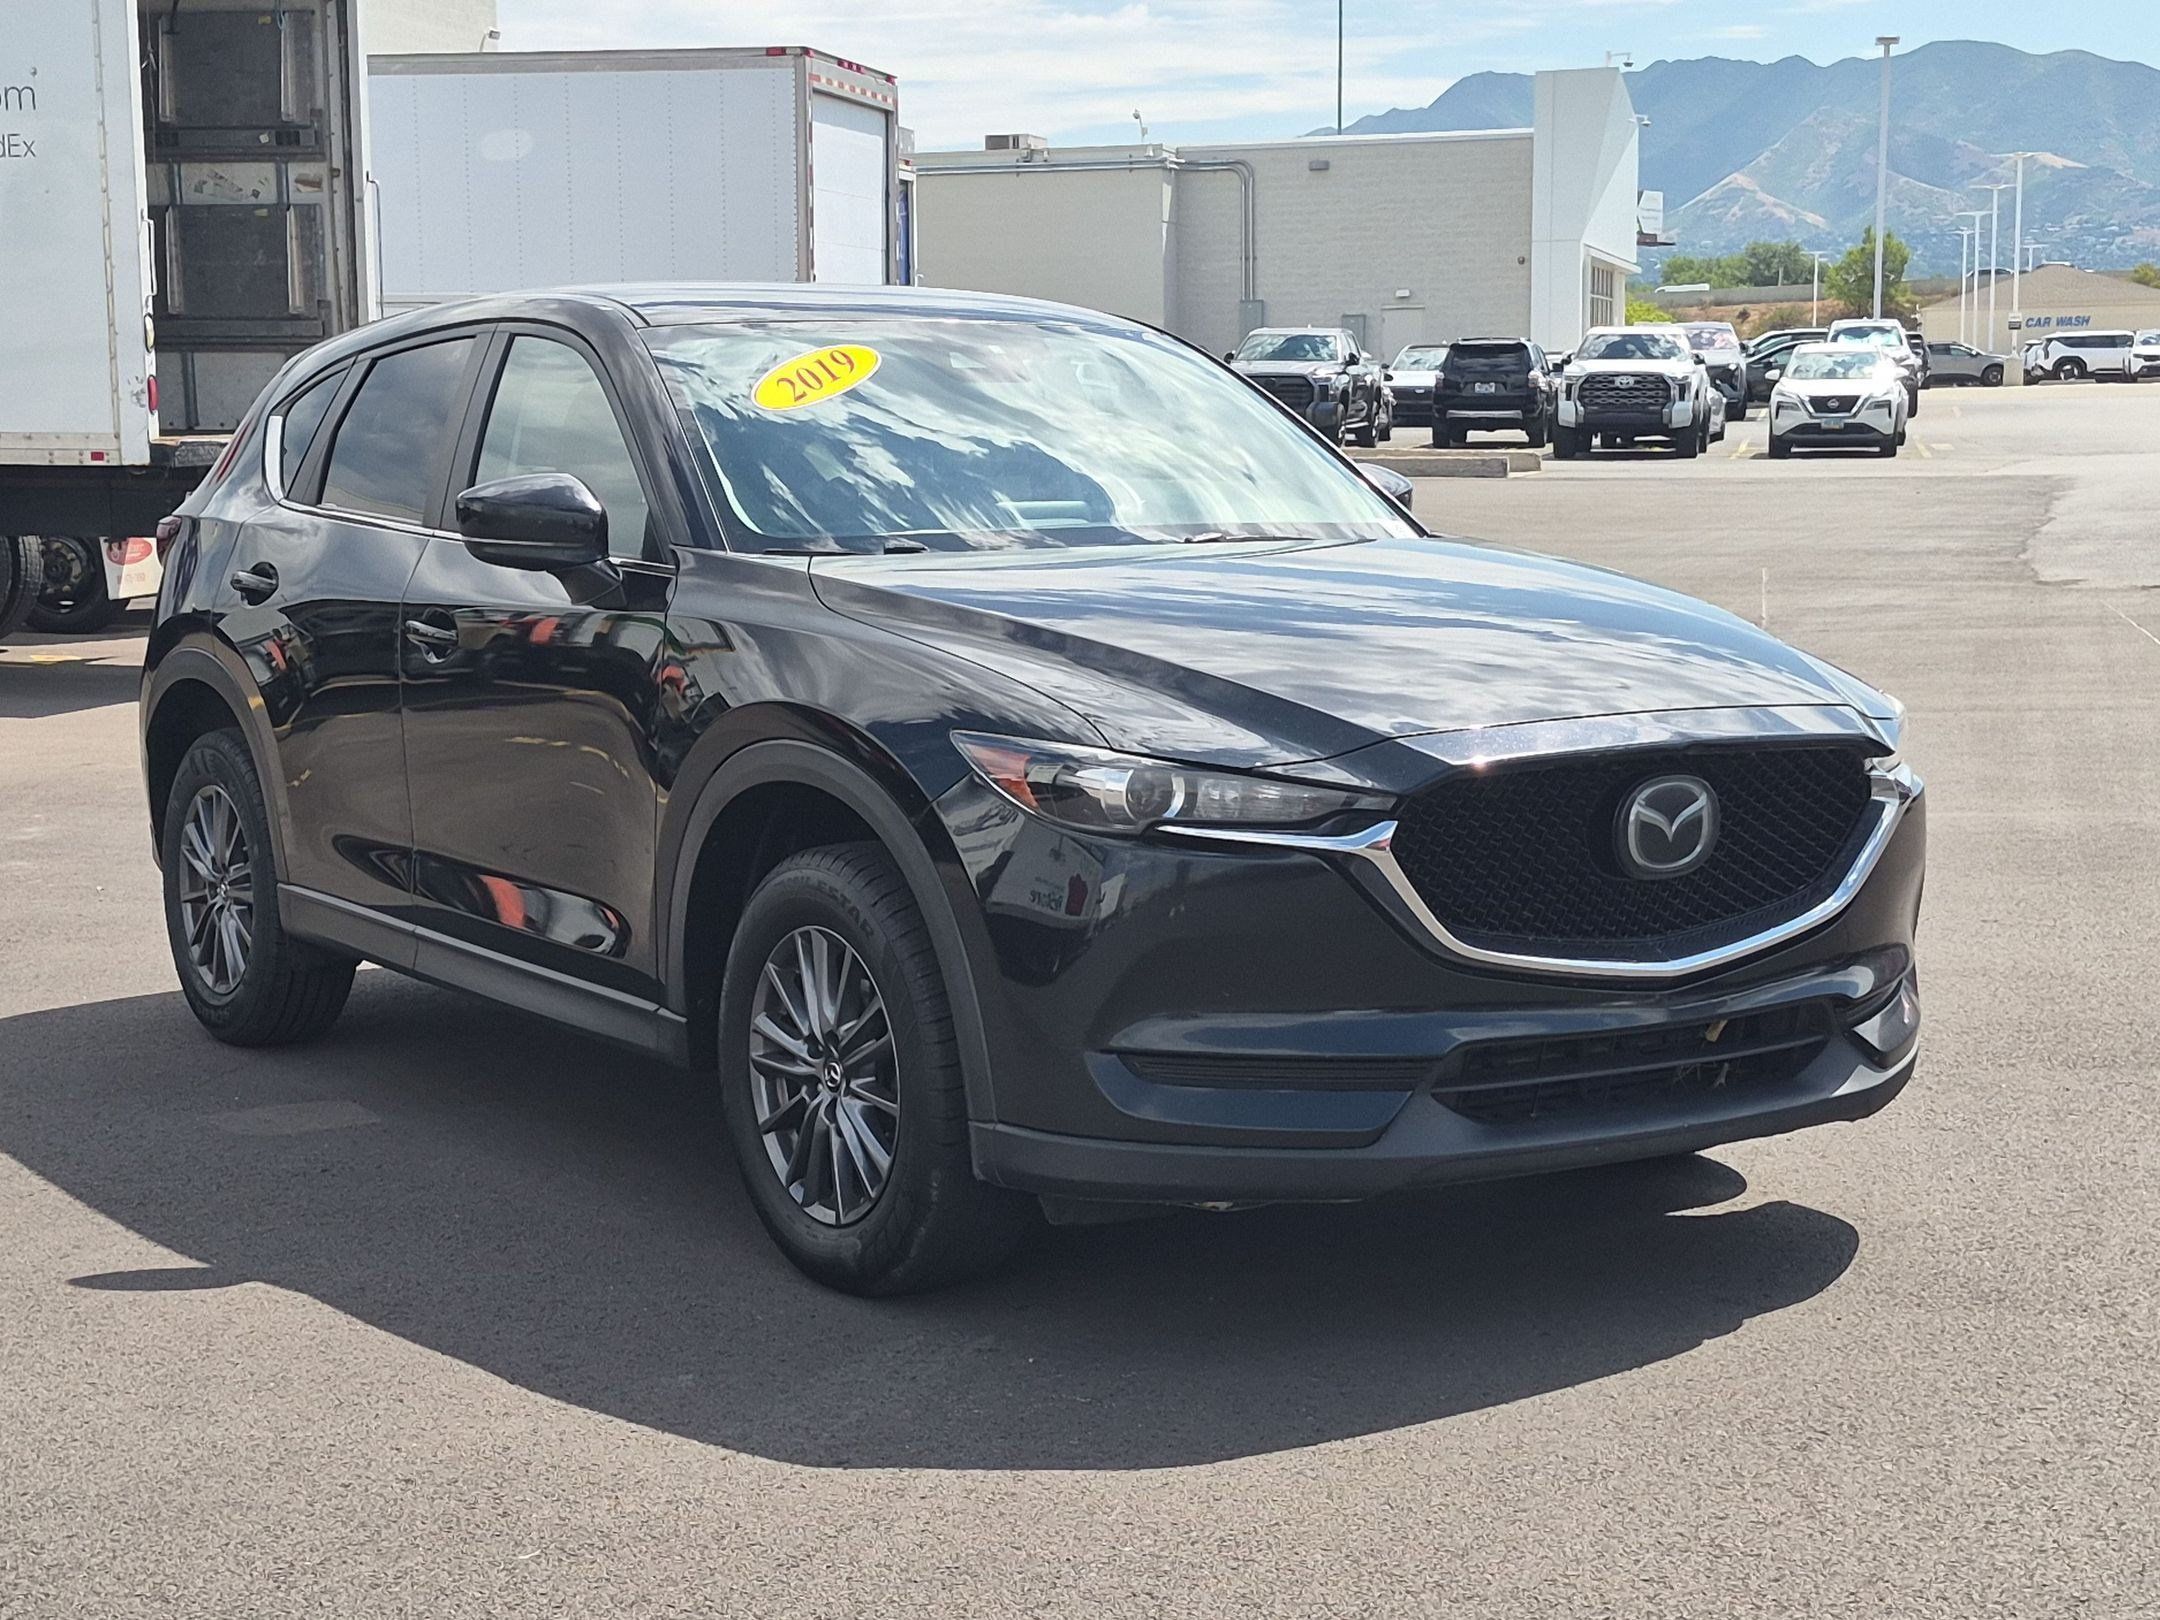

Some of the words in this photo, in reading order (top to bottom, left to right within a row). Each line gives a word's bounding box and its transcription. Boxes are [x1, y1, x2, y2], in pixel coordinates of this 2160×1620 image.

[2025, 316, 2052, 328] CAR
[2056, 315, 2091, 327] WASH
[776, 349, 855, 402] 2019
